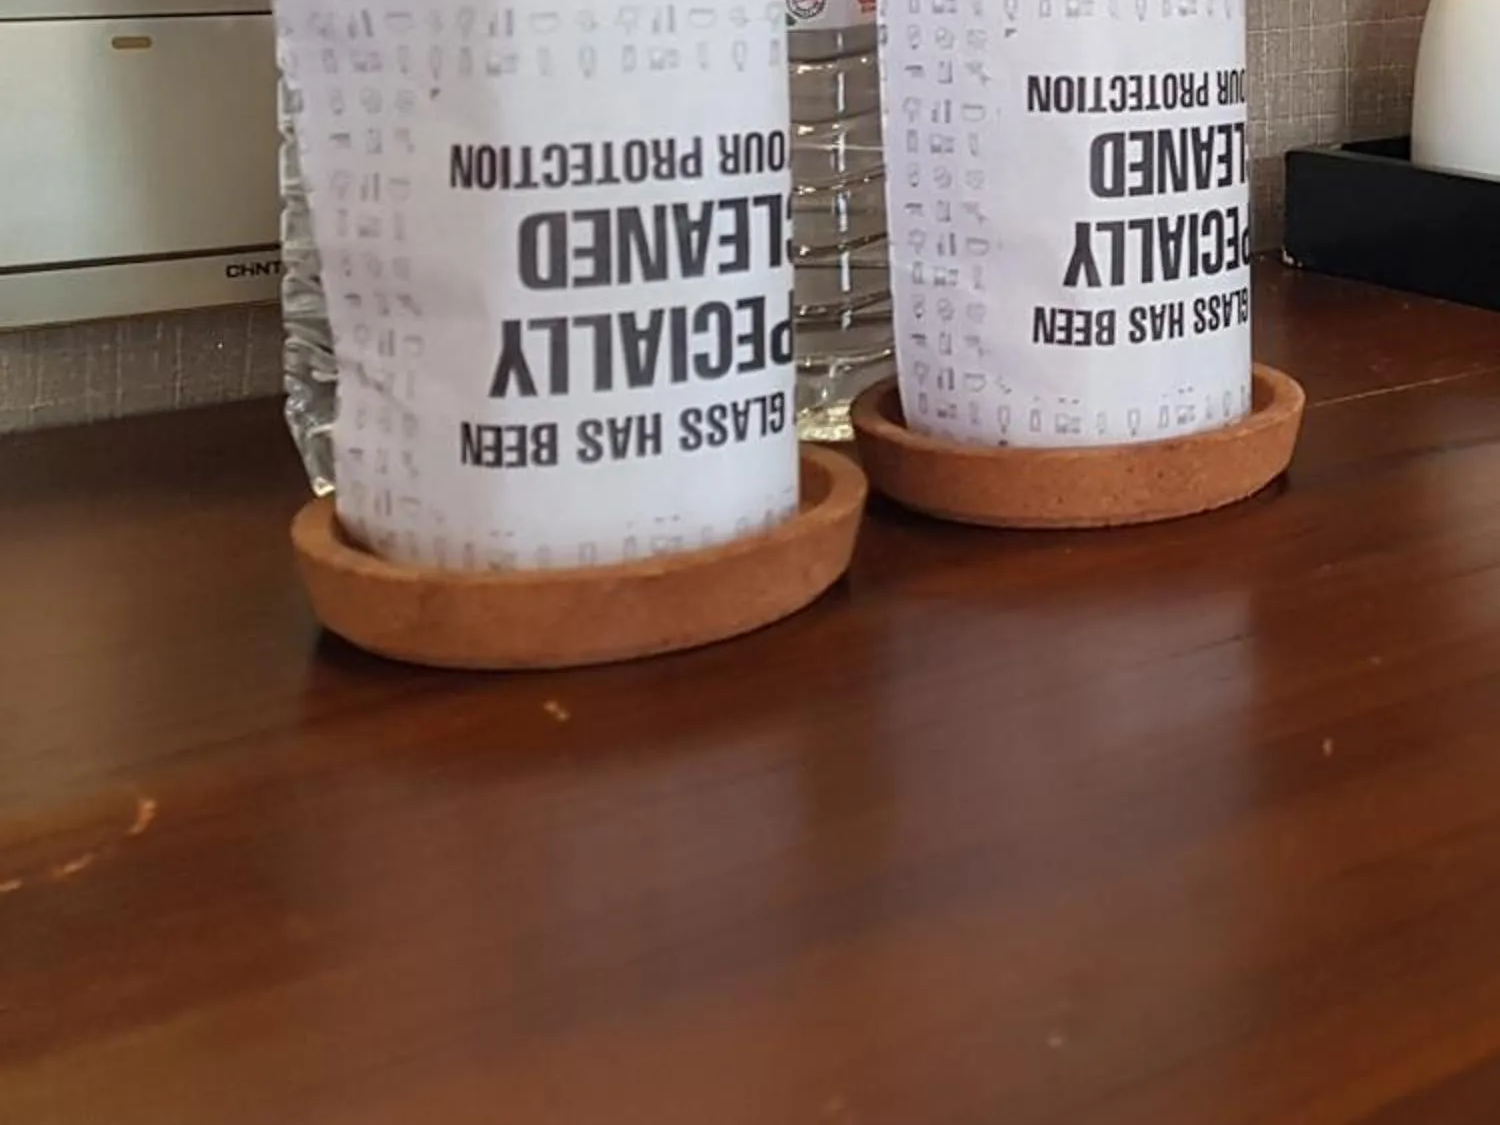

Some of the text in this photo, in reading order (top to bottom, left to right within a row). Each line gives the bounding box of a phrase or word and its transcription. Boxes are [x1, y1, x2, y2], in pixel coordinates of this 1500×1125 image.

[1027, 72, 1209, 113] PROTECTION
[450, 136, 703, 190] PROTECTION
[1090, 122, 1248, 198] LEANED
[518, 193, 793, 290] LEANED
[1032, 306, 1116, 346] BEEN
[1129, 301, 1185, 345] HAS
[460, 391, 785, 469] GLASS HAS BEEN
